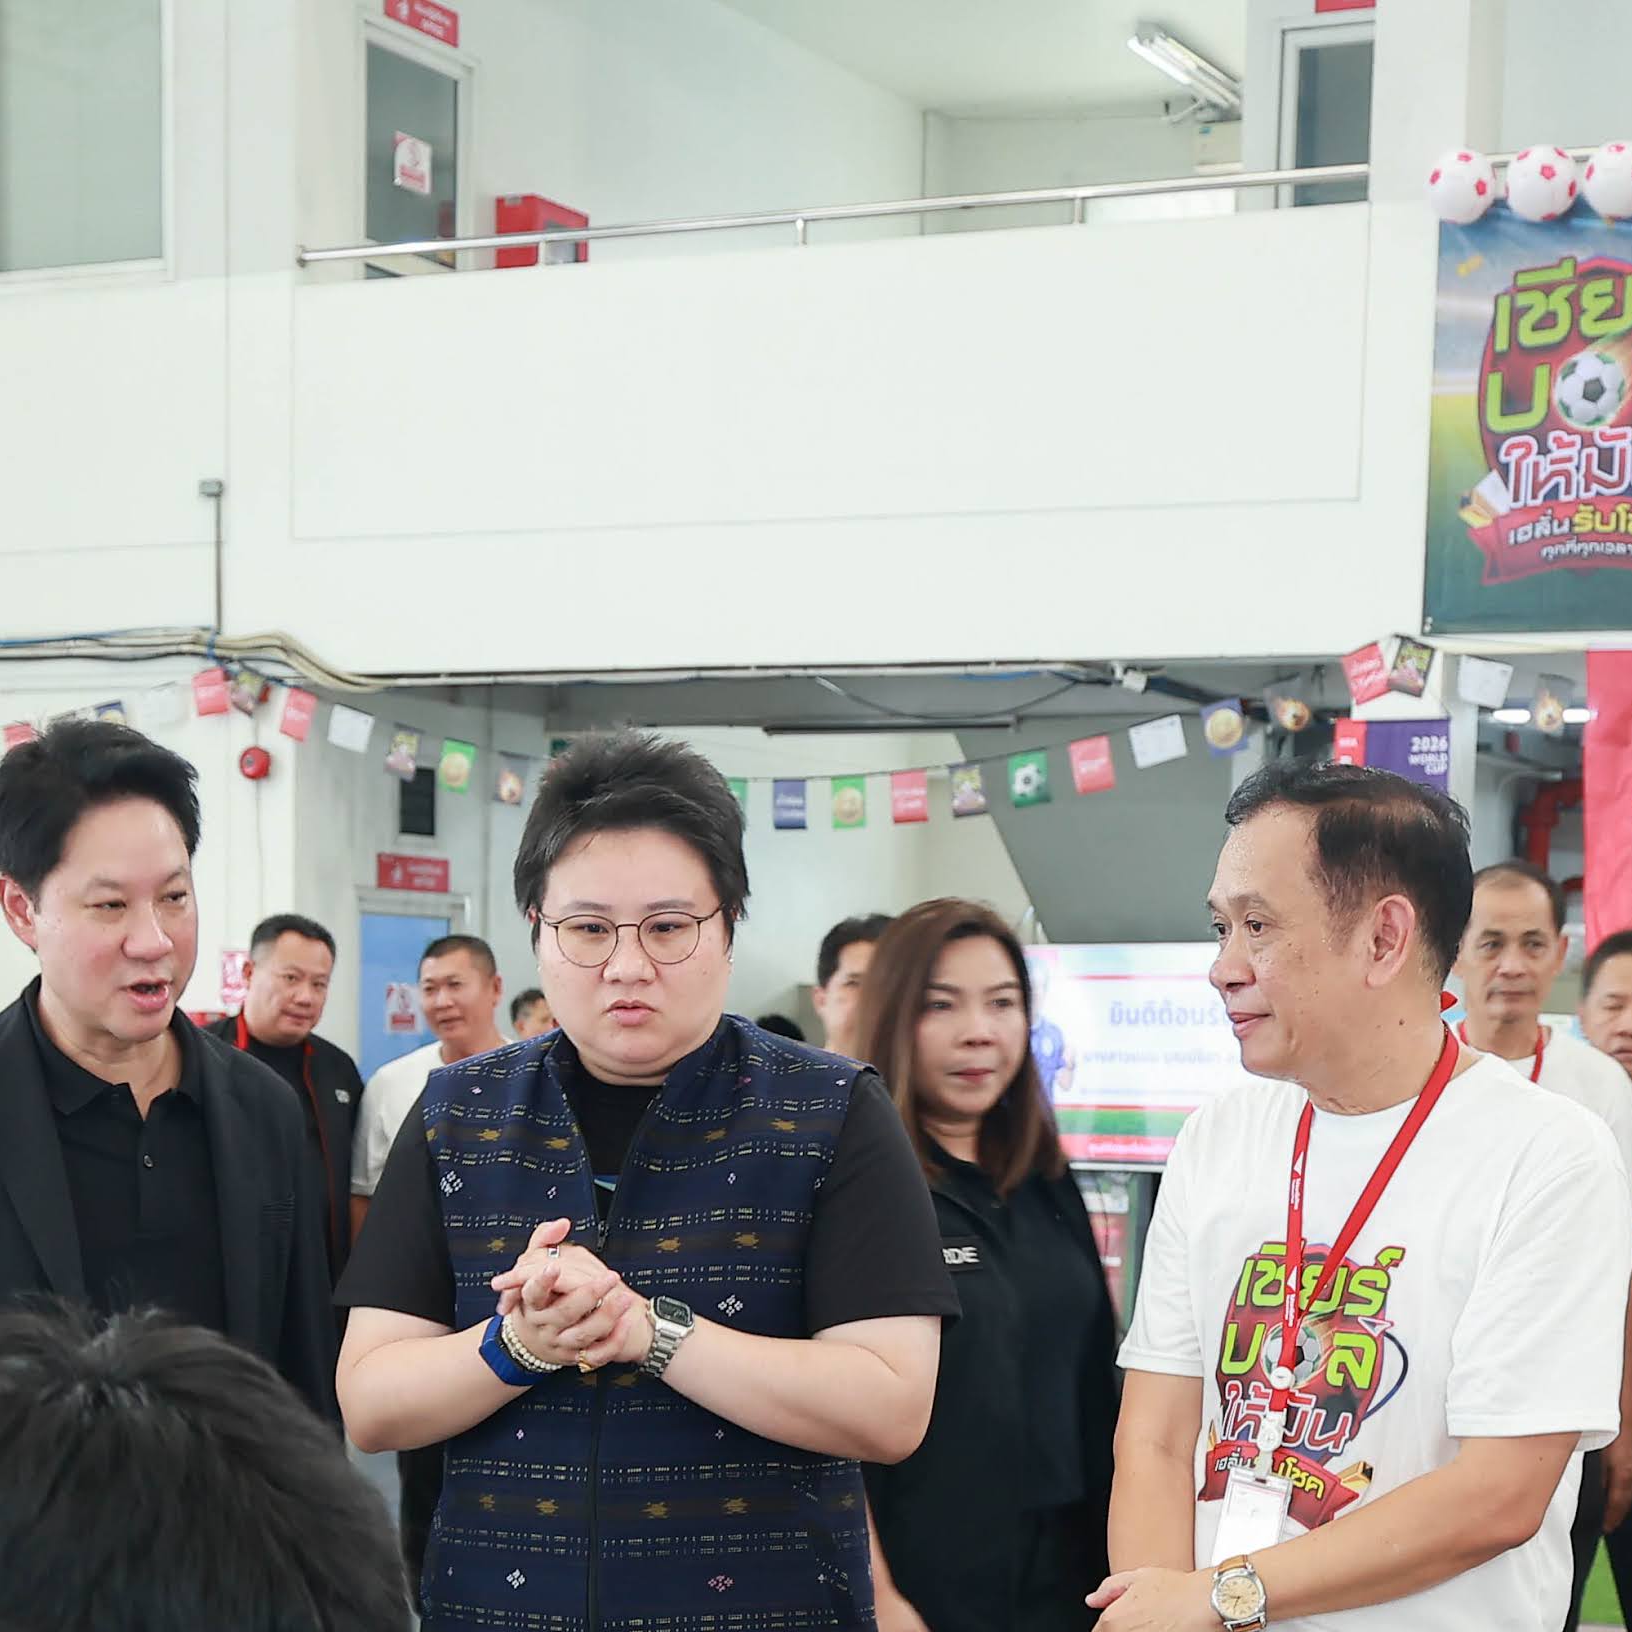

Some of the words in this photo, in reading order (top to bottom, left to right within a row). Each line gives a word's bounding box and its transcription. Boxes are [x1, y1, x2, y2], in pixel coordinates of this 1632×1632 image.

[1410, 735, 1448, 753] 2026
[1408, 752, 1448, 767] WORLD
[1424, 763, 1448, 776] CUP
